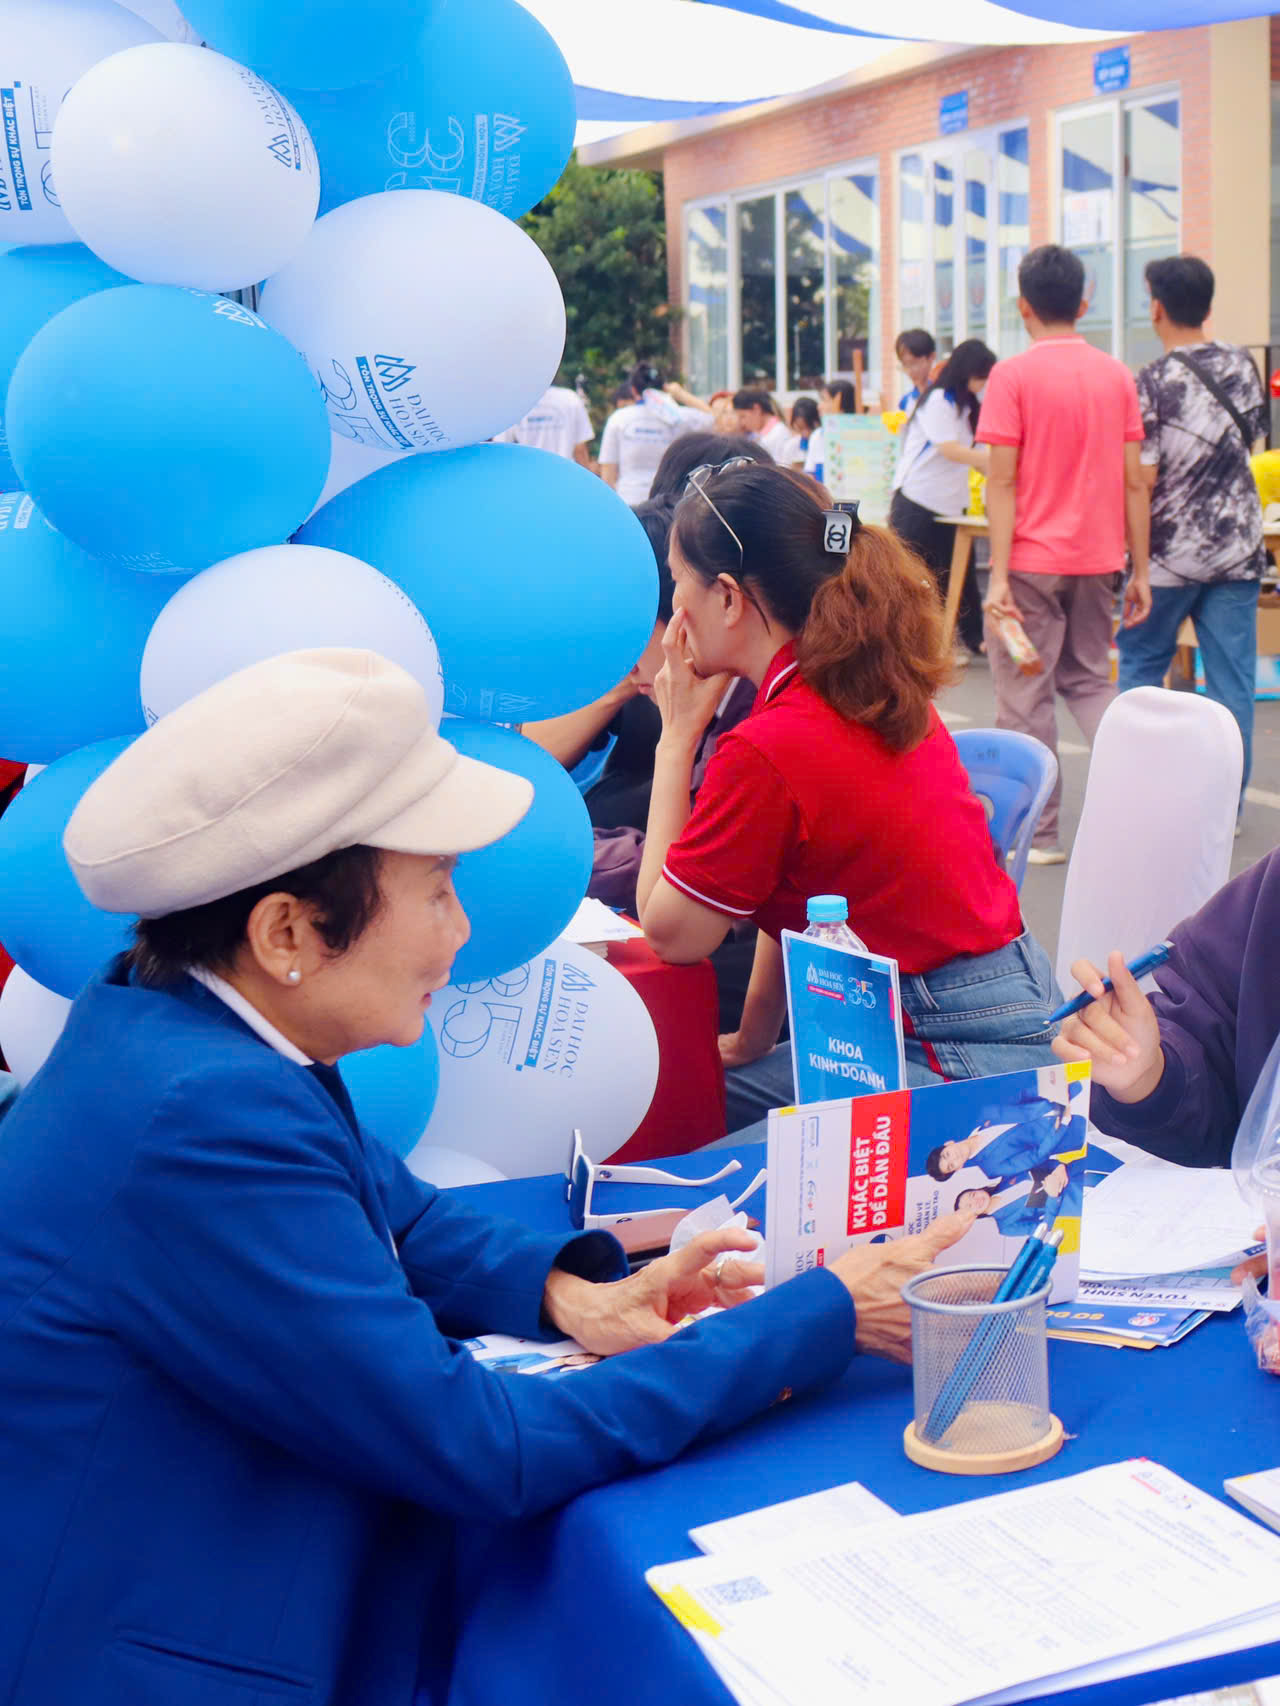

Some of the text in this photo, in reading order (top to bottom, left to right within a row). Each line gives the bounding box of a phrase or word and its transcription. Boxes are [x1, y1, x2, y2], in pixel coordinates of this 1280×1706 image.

[847, 976, 877, 1009] 35
[828, 1036, 864, 1062] KHOA
[808, 1052, 887, 1092] KINH DOANH
[851, 1136, 875, 1229] KHÁC BIỆT
[1083, 1288, 1127, 1297] SINH
